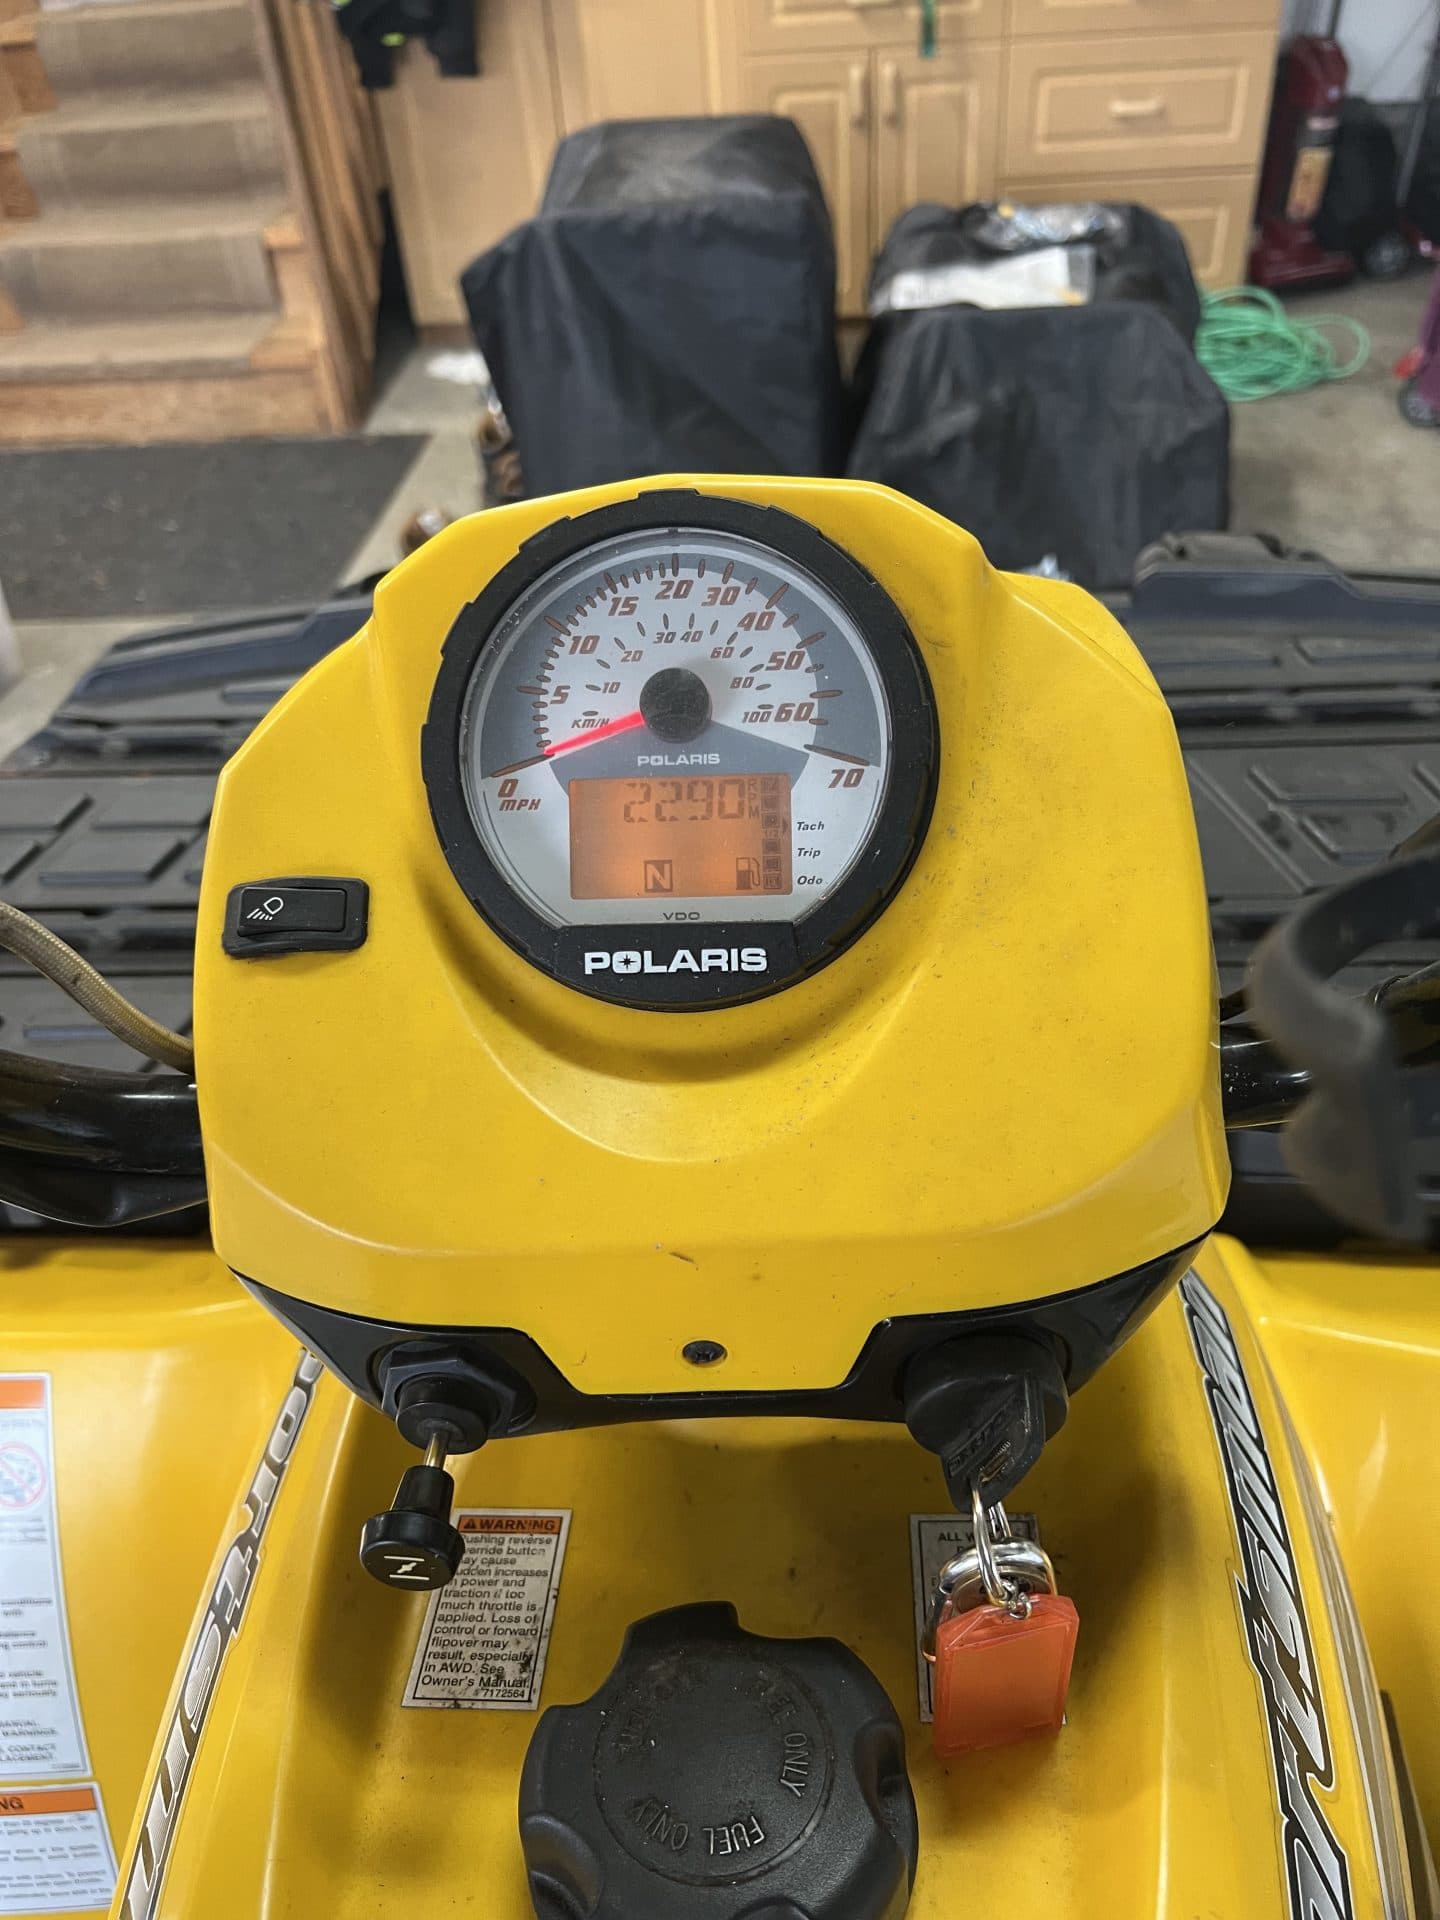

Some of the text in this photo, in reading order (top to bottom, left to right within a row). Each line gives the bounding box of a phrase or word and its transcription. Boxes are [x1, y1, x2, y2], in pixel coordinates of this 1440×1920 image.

[655, 579, 691, 600] 20
[702, 585, 740, 607] 30
[608, 596, 639, 617] 15
[737, 611, 776, 631] 40
[653, 631, 677, 644] 30
[679, 630, 703, 643] 40
[568, 635, 600, 655] 10
[621, 650, 643, 662] 20
[710, 646, 733, 659] 60
[767, 650, 805, 671] 50
[602, 681, 620, 694] 10
[730, 677, 754, 689] 80
[550, 685, 571, 705] 5
[742, 711, 771, 724] 100
[774, 702, 812, 722] 60
[637, 753, 721, 767] POLARIS
[828, 768, 865, 788] 70
[497, 779, 519, 798] 0
[499, 798, 541, 811] MPH
[623, 778, 746, 823] 2290
[796, 821, 825, 832] Tach
[796, 848, 821, 859] Trip
[647, 862, 671, 890] N
[796, 876, 823, 886] Odo
[662, 912, 700, 921] VDO
[583, 947, 768, 975] POLARIS
[480, 1519, 556, 1531] WARNING
[508, 1536, 553, 1545] reverse
[937, 1532, 964, 1543] ALL
[506, 1545, 546, 1556] button
[461, 1556, 517, 1566] ay cause
[455, 1566, 549, 1577] udden increases
[460, 1578, 499, 1588] power
[502, 1578, 526, 1587] and
[444, 1588, 491, 1599] traction
[505, 1589, 526, 1599] too
[440, 1601, 537, 1612] much throttle is
[437, 1613, 538, 1625] applied. Loss of
[434, 1625, 538, 1636] control or forward
[431, 1637, 509, 1650] flipover may
[427, 1651, 533, 1663] result, especially
[439, 1663, 476, 1674] AWD.
[479, 1664, 505, 1674] See
[421, 1675, 475, 1687] Owner's
[482, 1689, 525, 1698] 7172564
[779, 1732, 809, 1798] ONLY
[632, 1797, 766, 1855] FUEL ONLY
